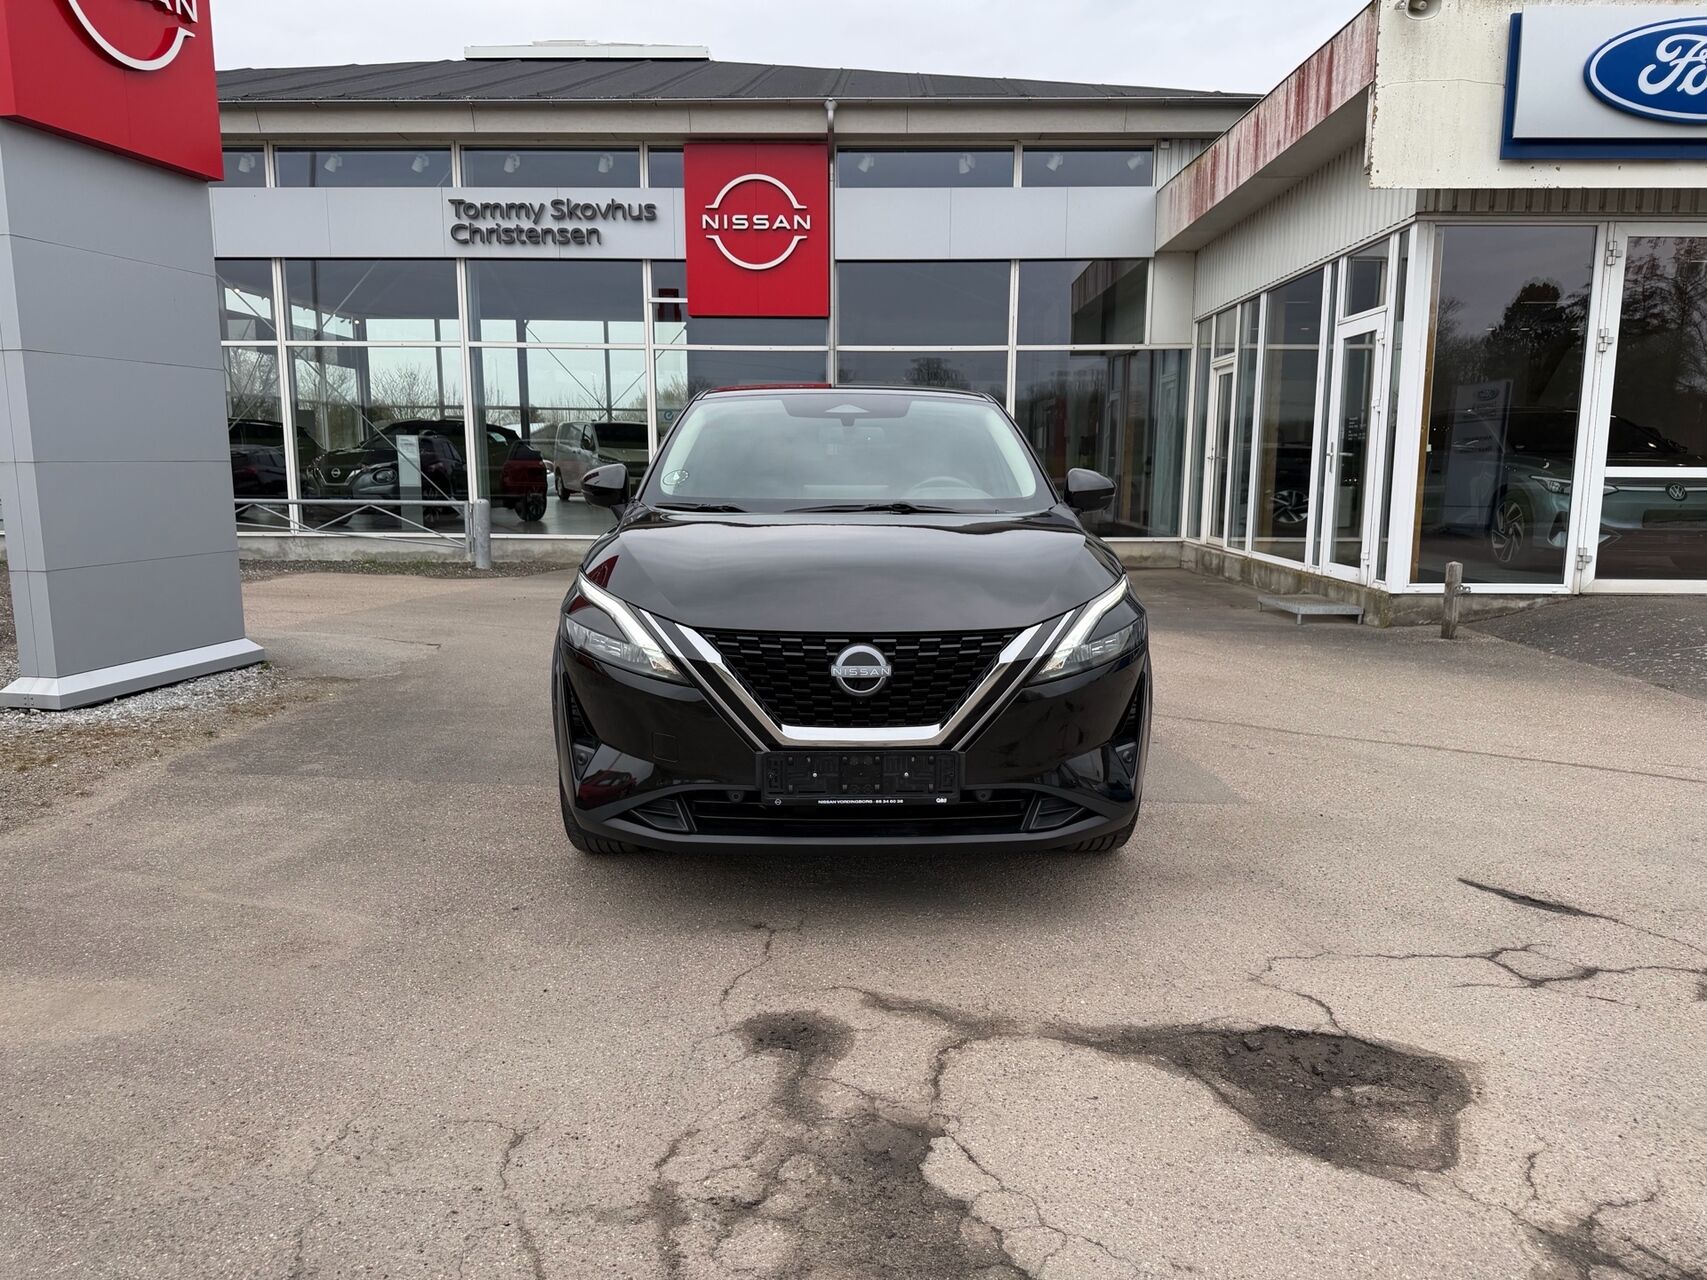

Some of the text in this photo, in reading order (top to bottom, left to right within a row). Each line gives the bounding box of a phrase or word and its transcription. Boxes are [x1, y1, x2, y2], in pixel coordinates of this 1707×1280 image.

[448, 198, 657, 225] Tommy Skovhus
[702, 214, 811, 230] NISSAN
[450, 222, 602, 246] Christensen
[832, 668, 890, 676] NISSAN
